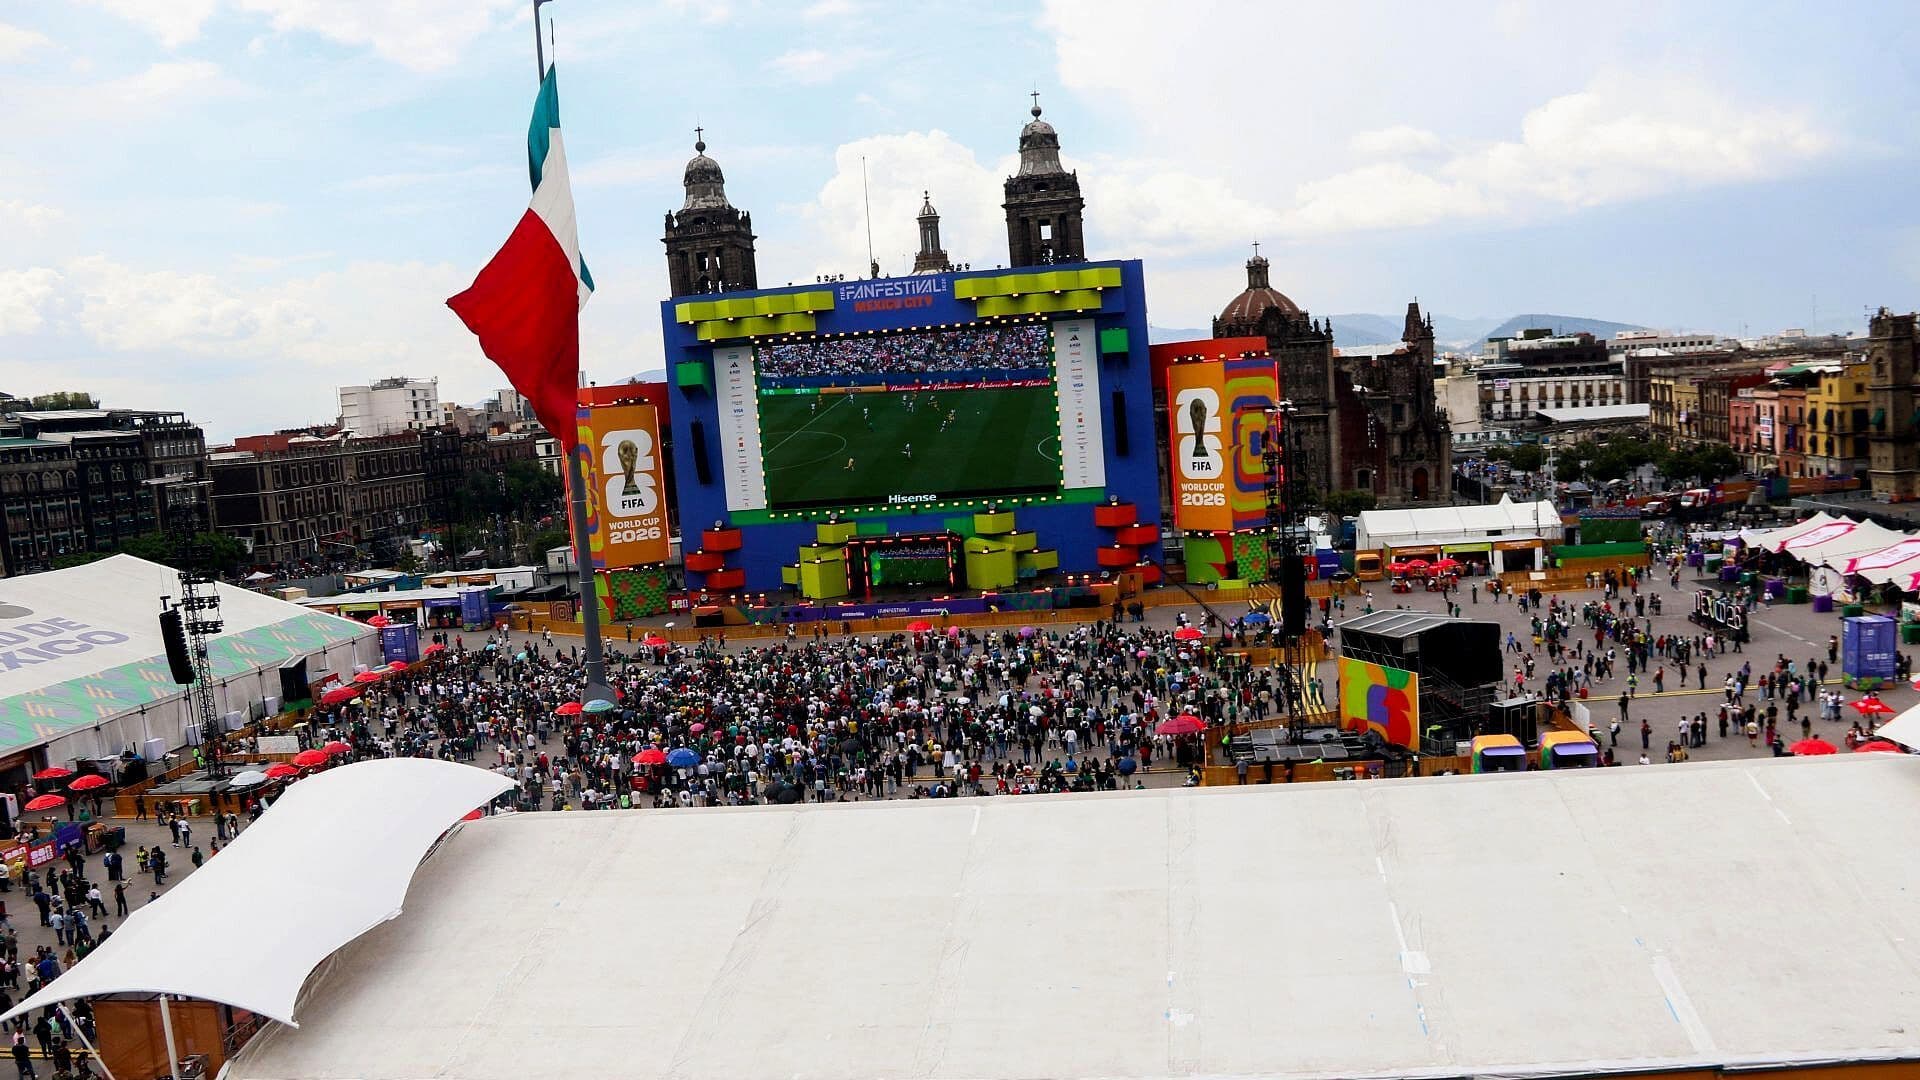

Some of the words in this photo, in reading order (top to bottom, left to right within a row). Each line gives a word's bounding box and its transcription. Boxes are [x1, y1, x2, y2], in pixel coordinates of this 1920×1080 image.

[854, 297, 902, 312] MEXICO
[904, 295, 933, 308] CITY
[1191, 461, 1212, 471] FIFA
[1180, 483, 1209, 492] WORLD
[1209, 483, 1225, 491] CUP
[621, 498, 645, 509] FIFA
[888, 493, 937, 504] Hisense
[1181, 492, 1226, 507] 2026
[608, 519, 641, 531] WORLD
[642, 517, 660, 527] CUP
[609, 526, 661, 545] 2026
[12, 616, 91, 638] DE
[0, 630, 130, 672] XICO
